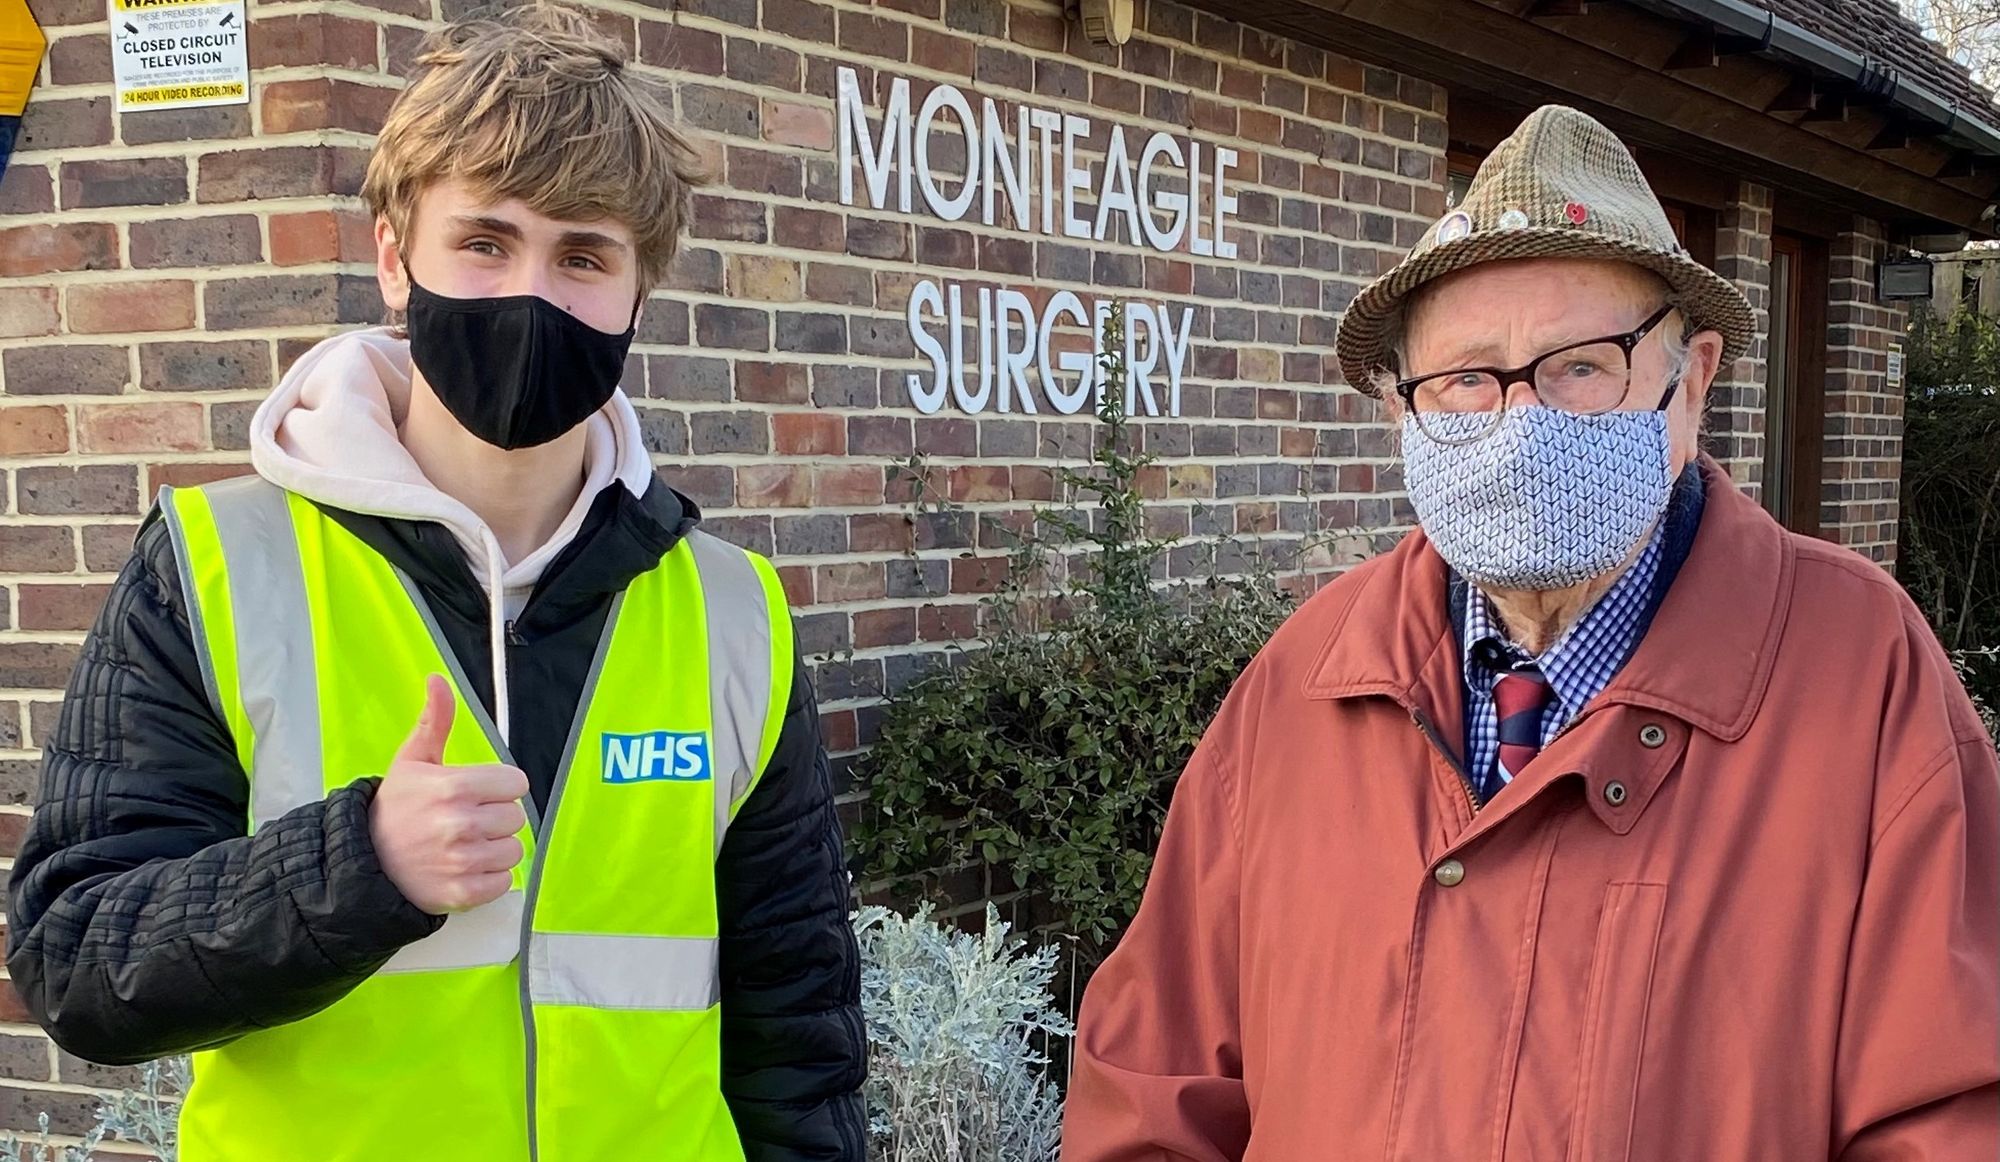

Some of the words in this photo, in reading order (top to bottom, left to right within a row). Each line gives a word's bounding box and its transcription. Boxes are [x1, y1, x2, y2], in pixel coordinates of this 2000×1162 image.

[136, 11, 160, 22] THESE
[162, 8, 204, 19] PREMISES
[205, 6, 222, 15] ARE
[148, 20, 196, 31] PROTECTED
[198, 18, 208, 28] BY
[123, 38, 176, 54] CLOSED
[180, 33, 237, 49] CIRCUIT
[140, 51, 222, 69] TELEVISION
[124, 92, 135, 103] 24
[136, 91, 160, 102] HOUR
[161, 88, 188, 100] VIDEO
[190, 84, 242, 98] RECORDING
[836, 66, 1238, 259] MONTEAGLE
[906, 280, 1194, 417] SURGERY
[603, 736, 703, 780] NHS
